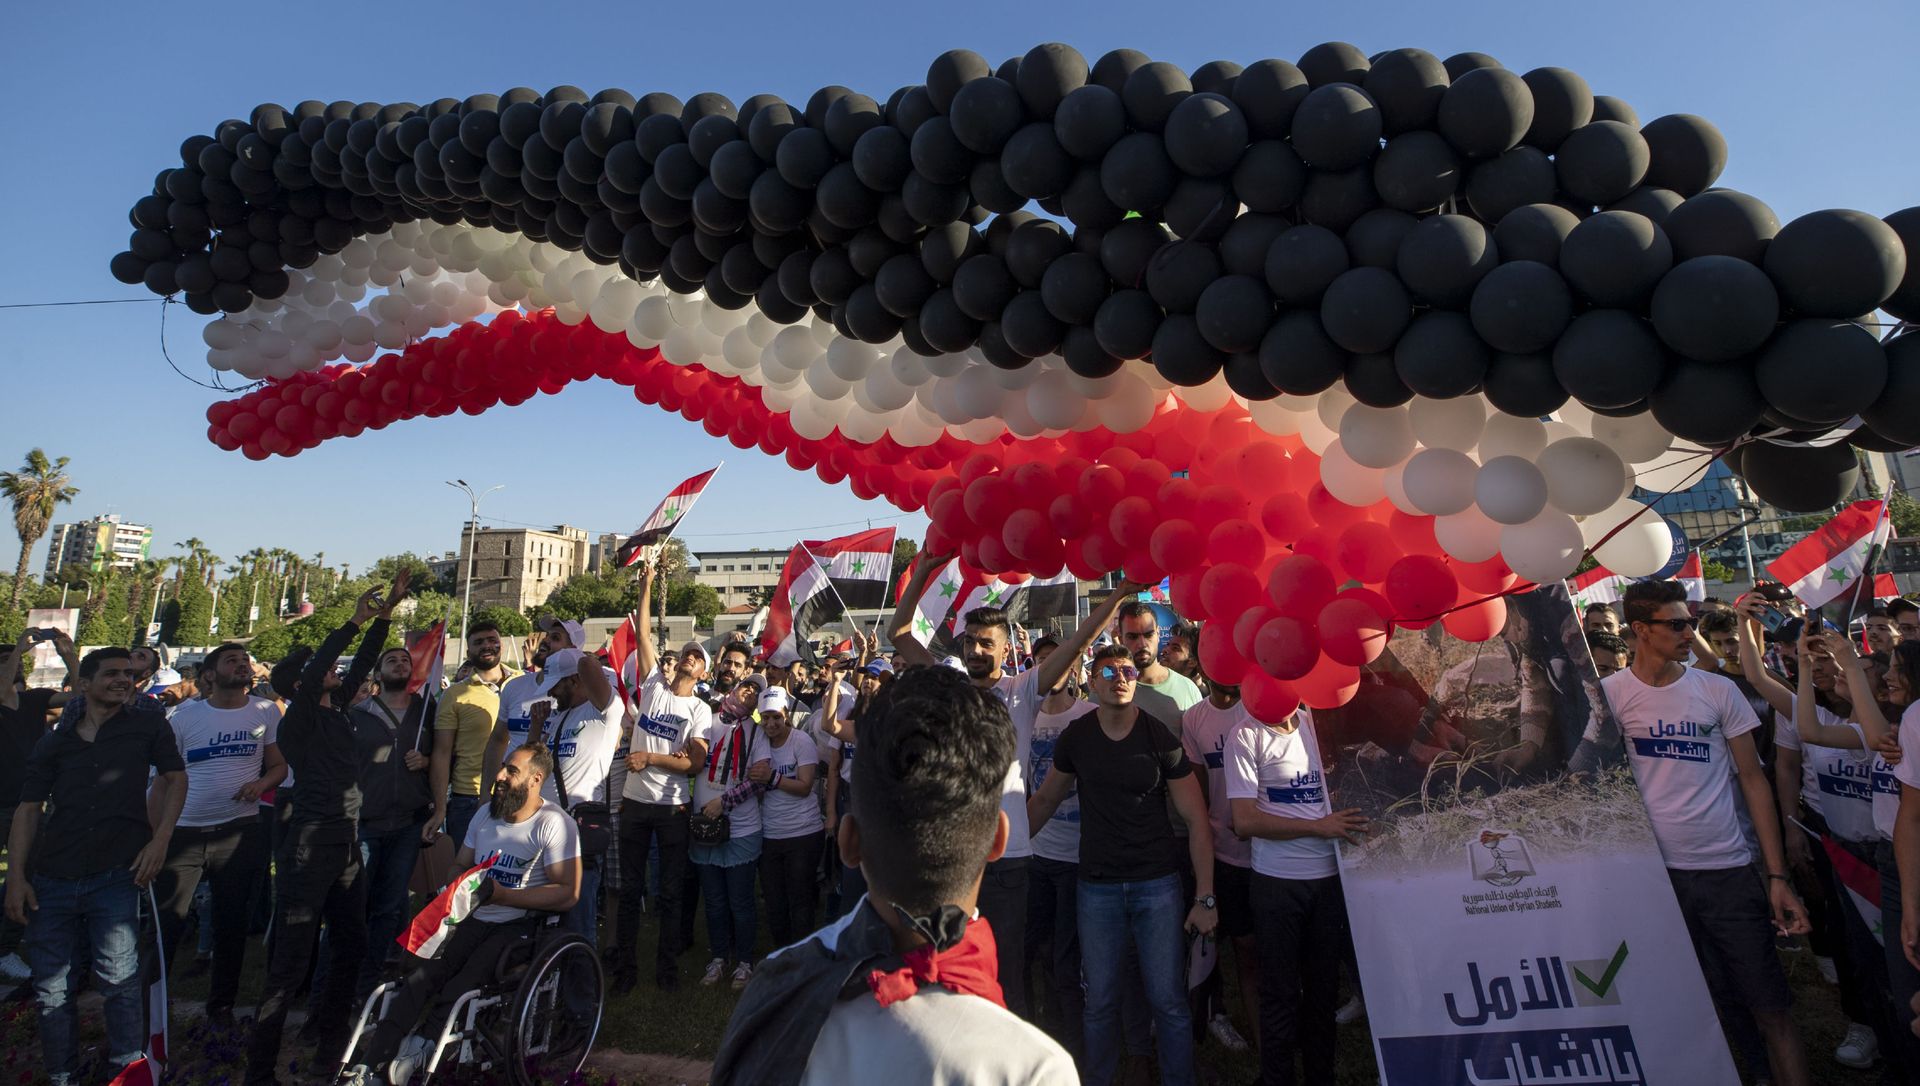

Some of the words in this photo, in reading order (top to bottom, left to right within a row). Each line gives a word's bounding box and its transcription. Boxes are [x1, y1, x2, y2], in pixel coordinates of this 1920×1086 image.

[1648, 719, 1697, 738] الأمل
[1654, 741, 1710, 762] بالشباب
[1465, 904, 1490, 916] National
[1490, 902, 1509, 914] Union
[1509, 902, 1515, 912] of
[1515, 900, 1535, 913] Syrian
[1535, 898, 1562, 910] Students
[1444, 956, 1574, 1027] الأمل
[1464, 1033, 1641, 1086] بالشباب
